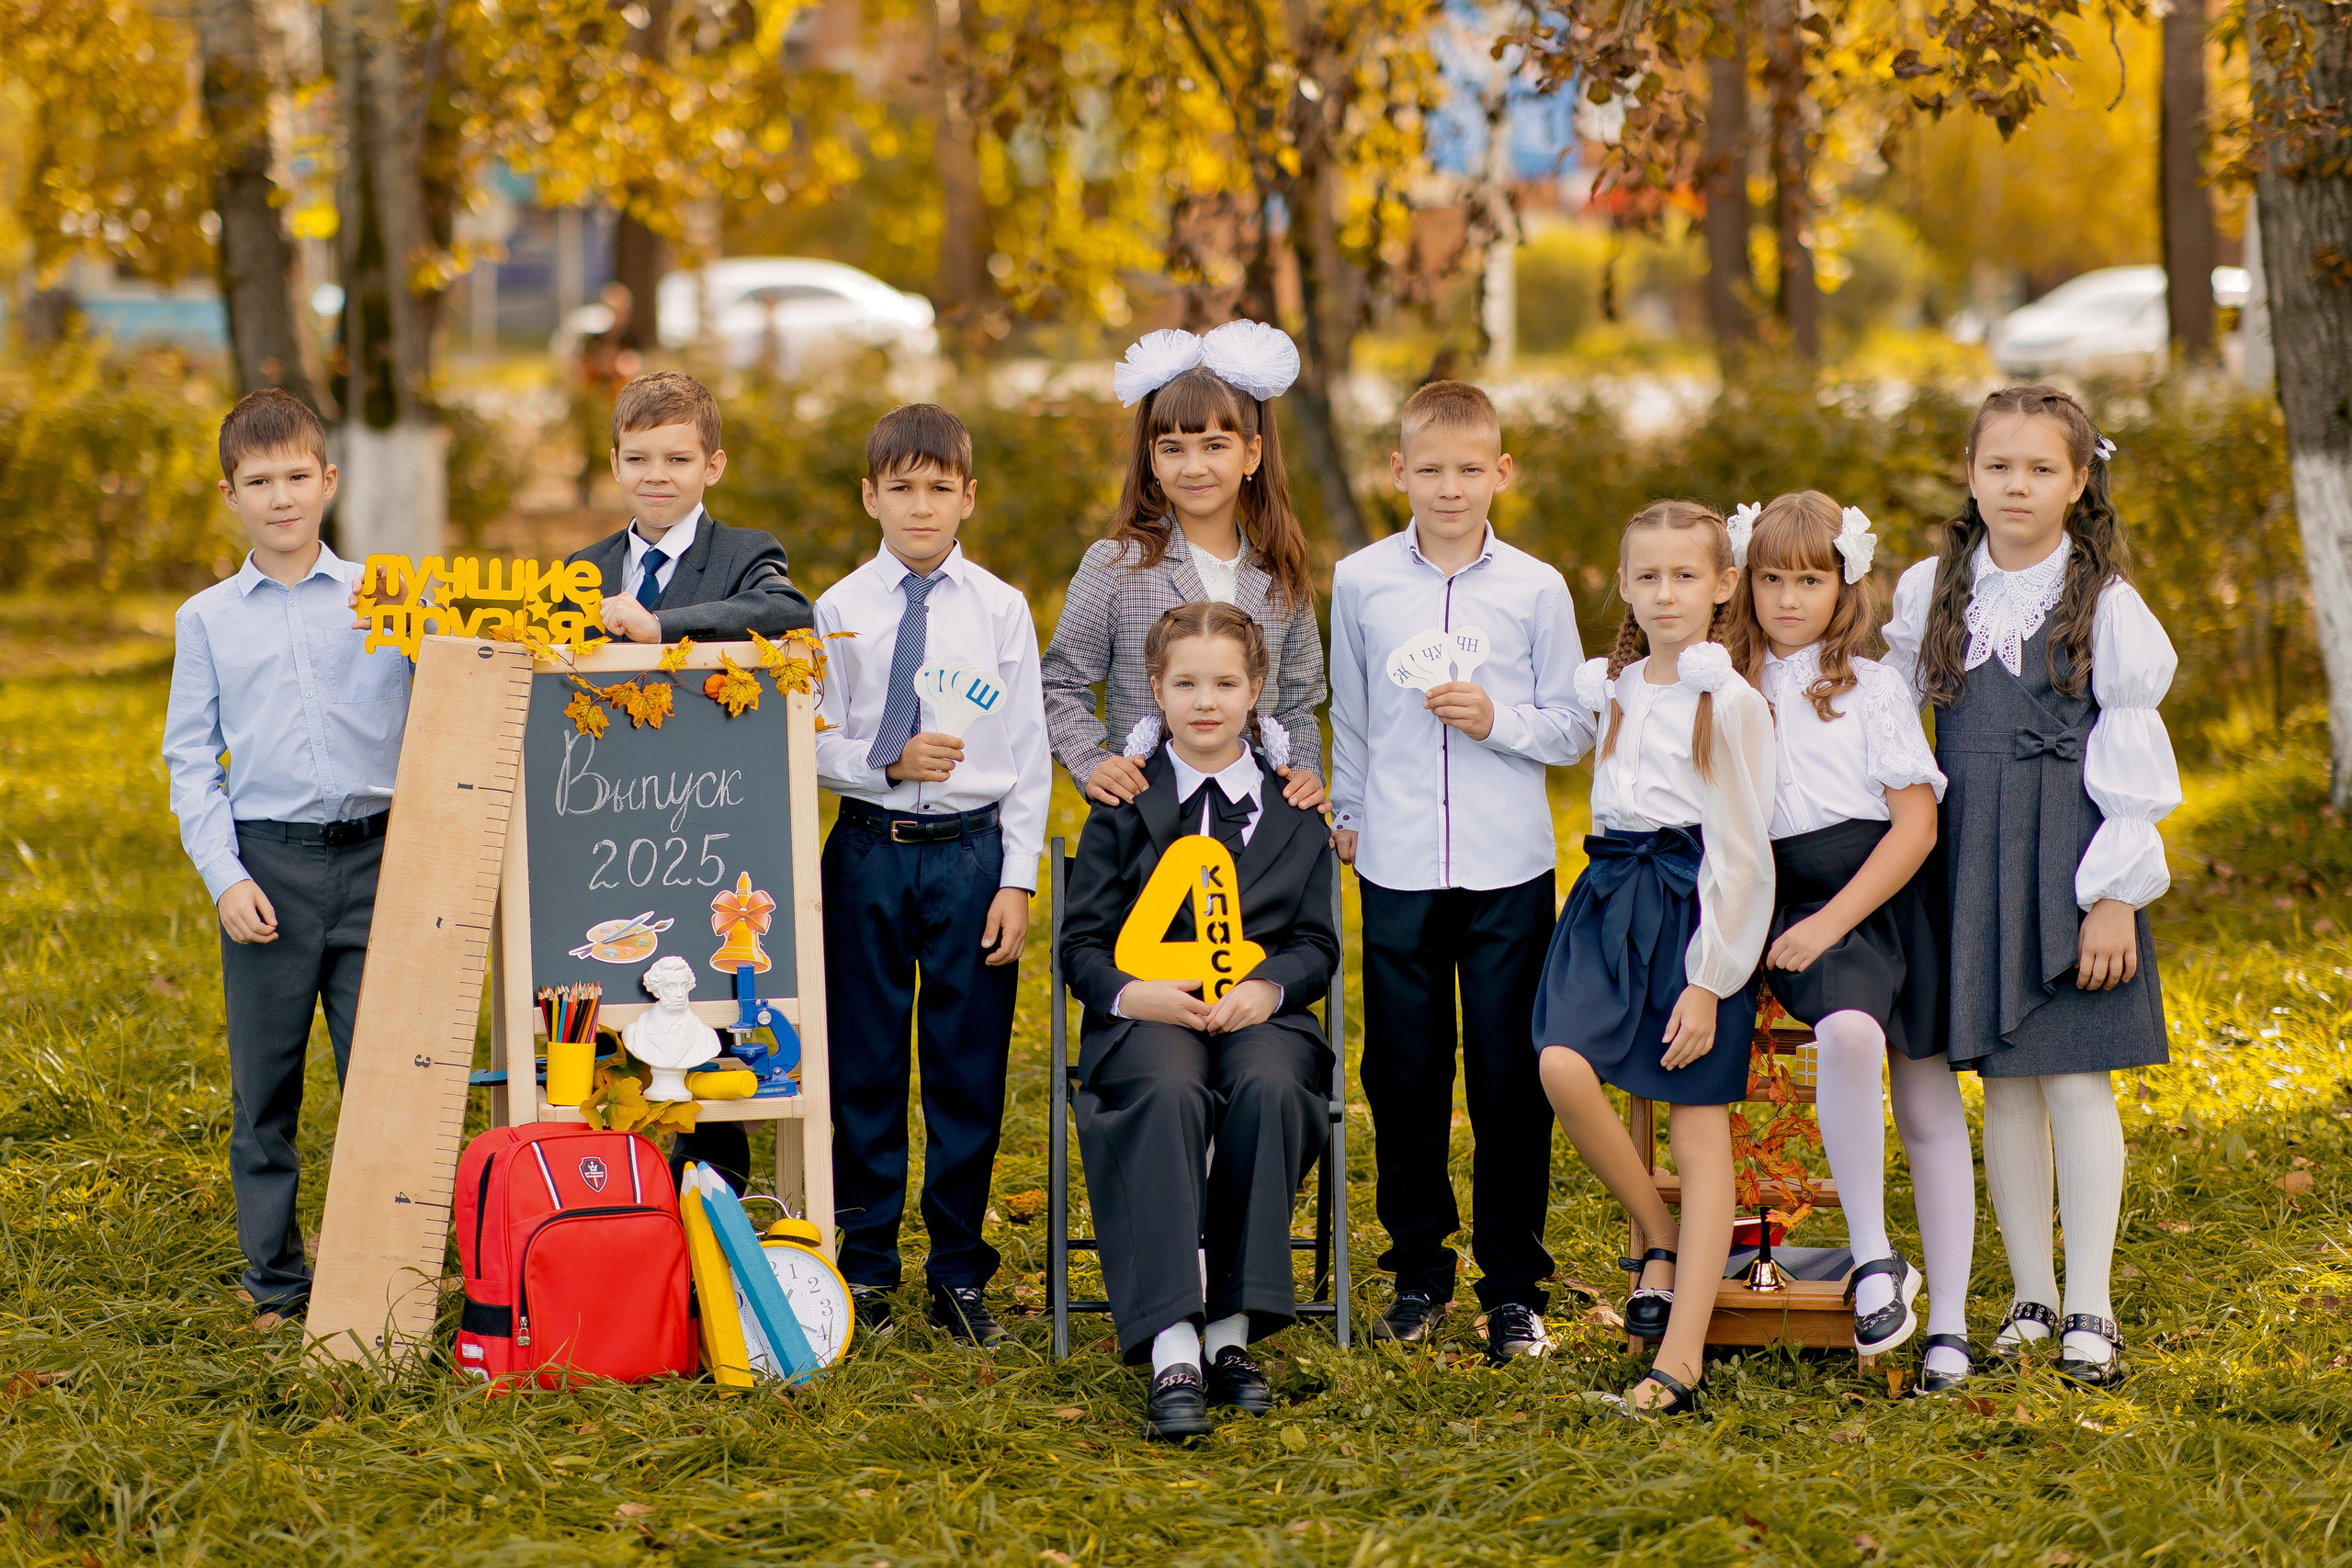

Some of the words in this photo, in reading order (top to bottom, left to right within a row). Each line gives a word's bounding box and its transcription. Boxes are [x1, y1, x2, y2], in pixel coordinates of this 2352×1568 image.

[1421, 644, 1442, 661] ЧУ
[1456, 636, 1479, 653] ЧН
[555, 728, 745, 833] Выпуск
[587, 832, 730, 890] 2025
[788, 1262, 798, 1280] 1
[807, 1276, 821, 1294] 2
[820, 1298, 834, 1317] 3
[816, 1324, 829, 1341] 4
